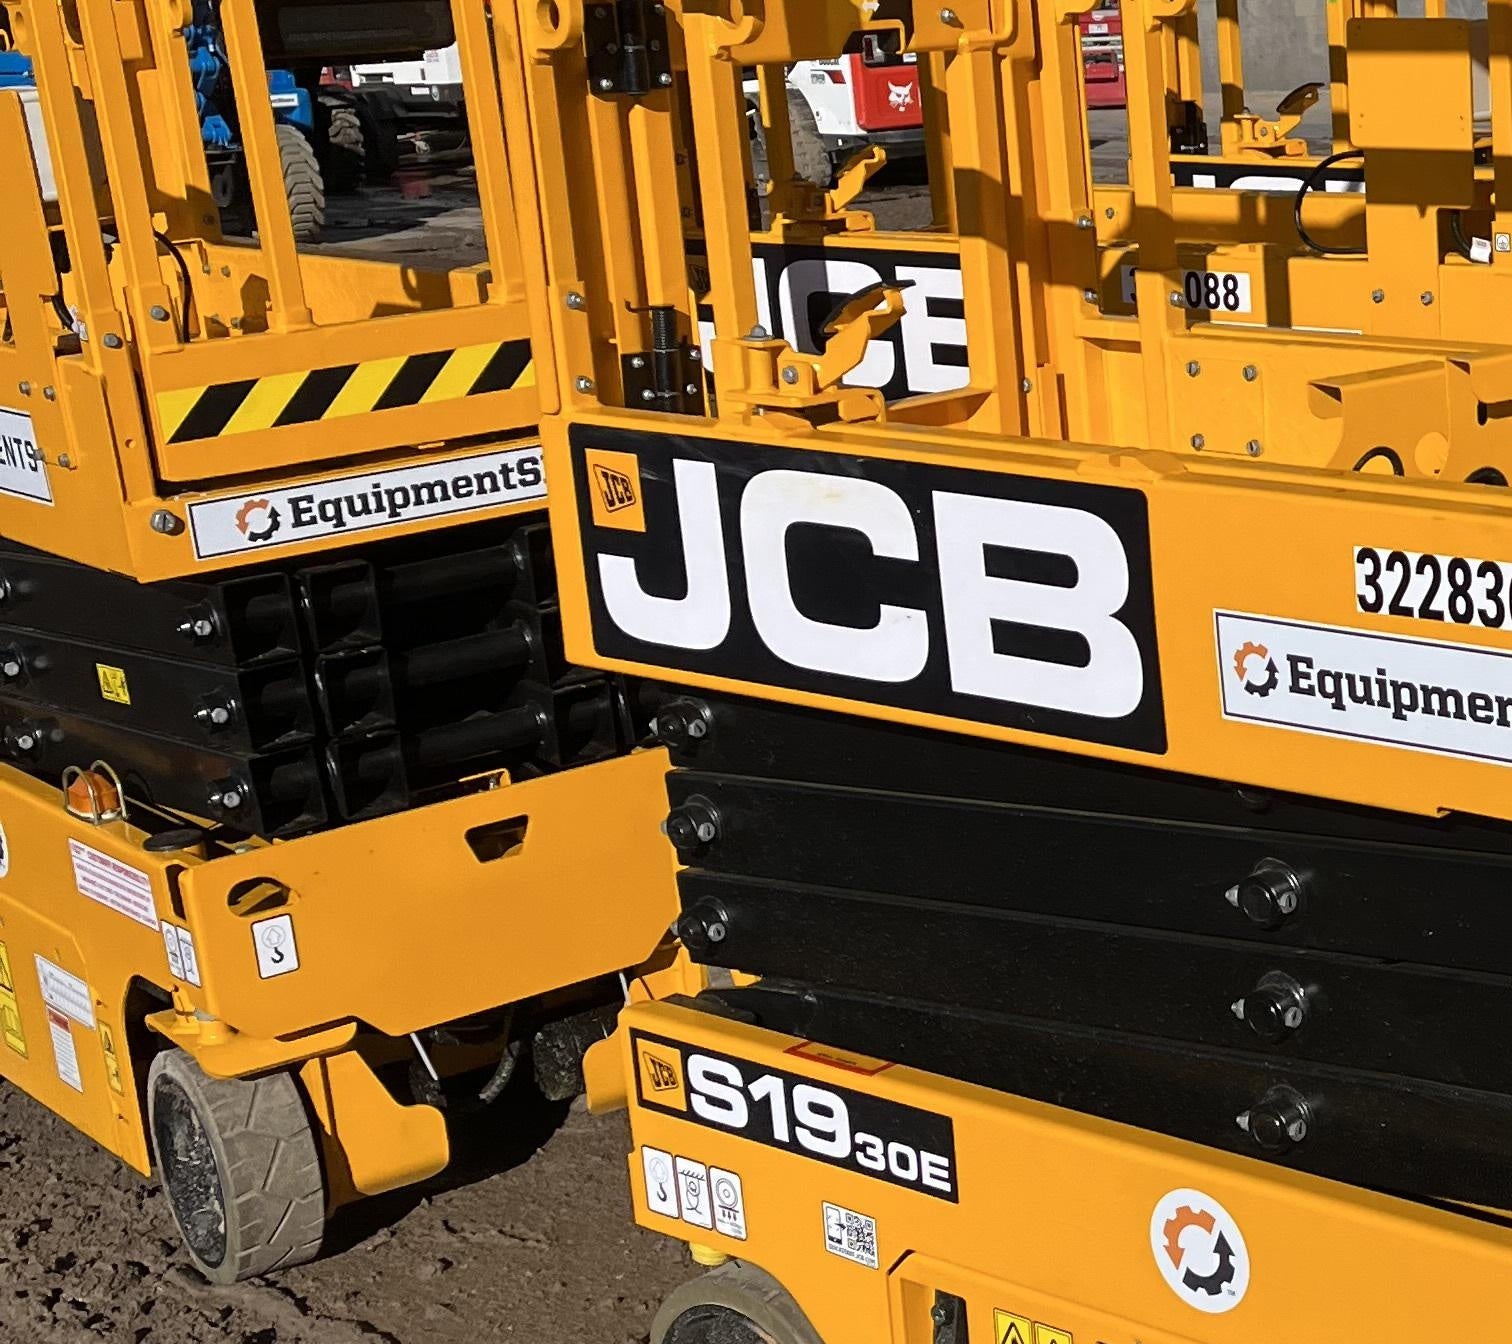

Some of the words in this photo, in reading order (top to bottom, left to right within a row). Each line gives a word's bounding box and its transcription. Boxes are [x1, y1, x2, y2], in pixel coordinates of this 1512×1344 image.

[288, 454, 547, 529] EquipmentS
[601, 469, 634, 506] JCB
[597, 458, 1144, 719] JCB
[650, 1055, 678, 1088] JCB
